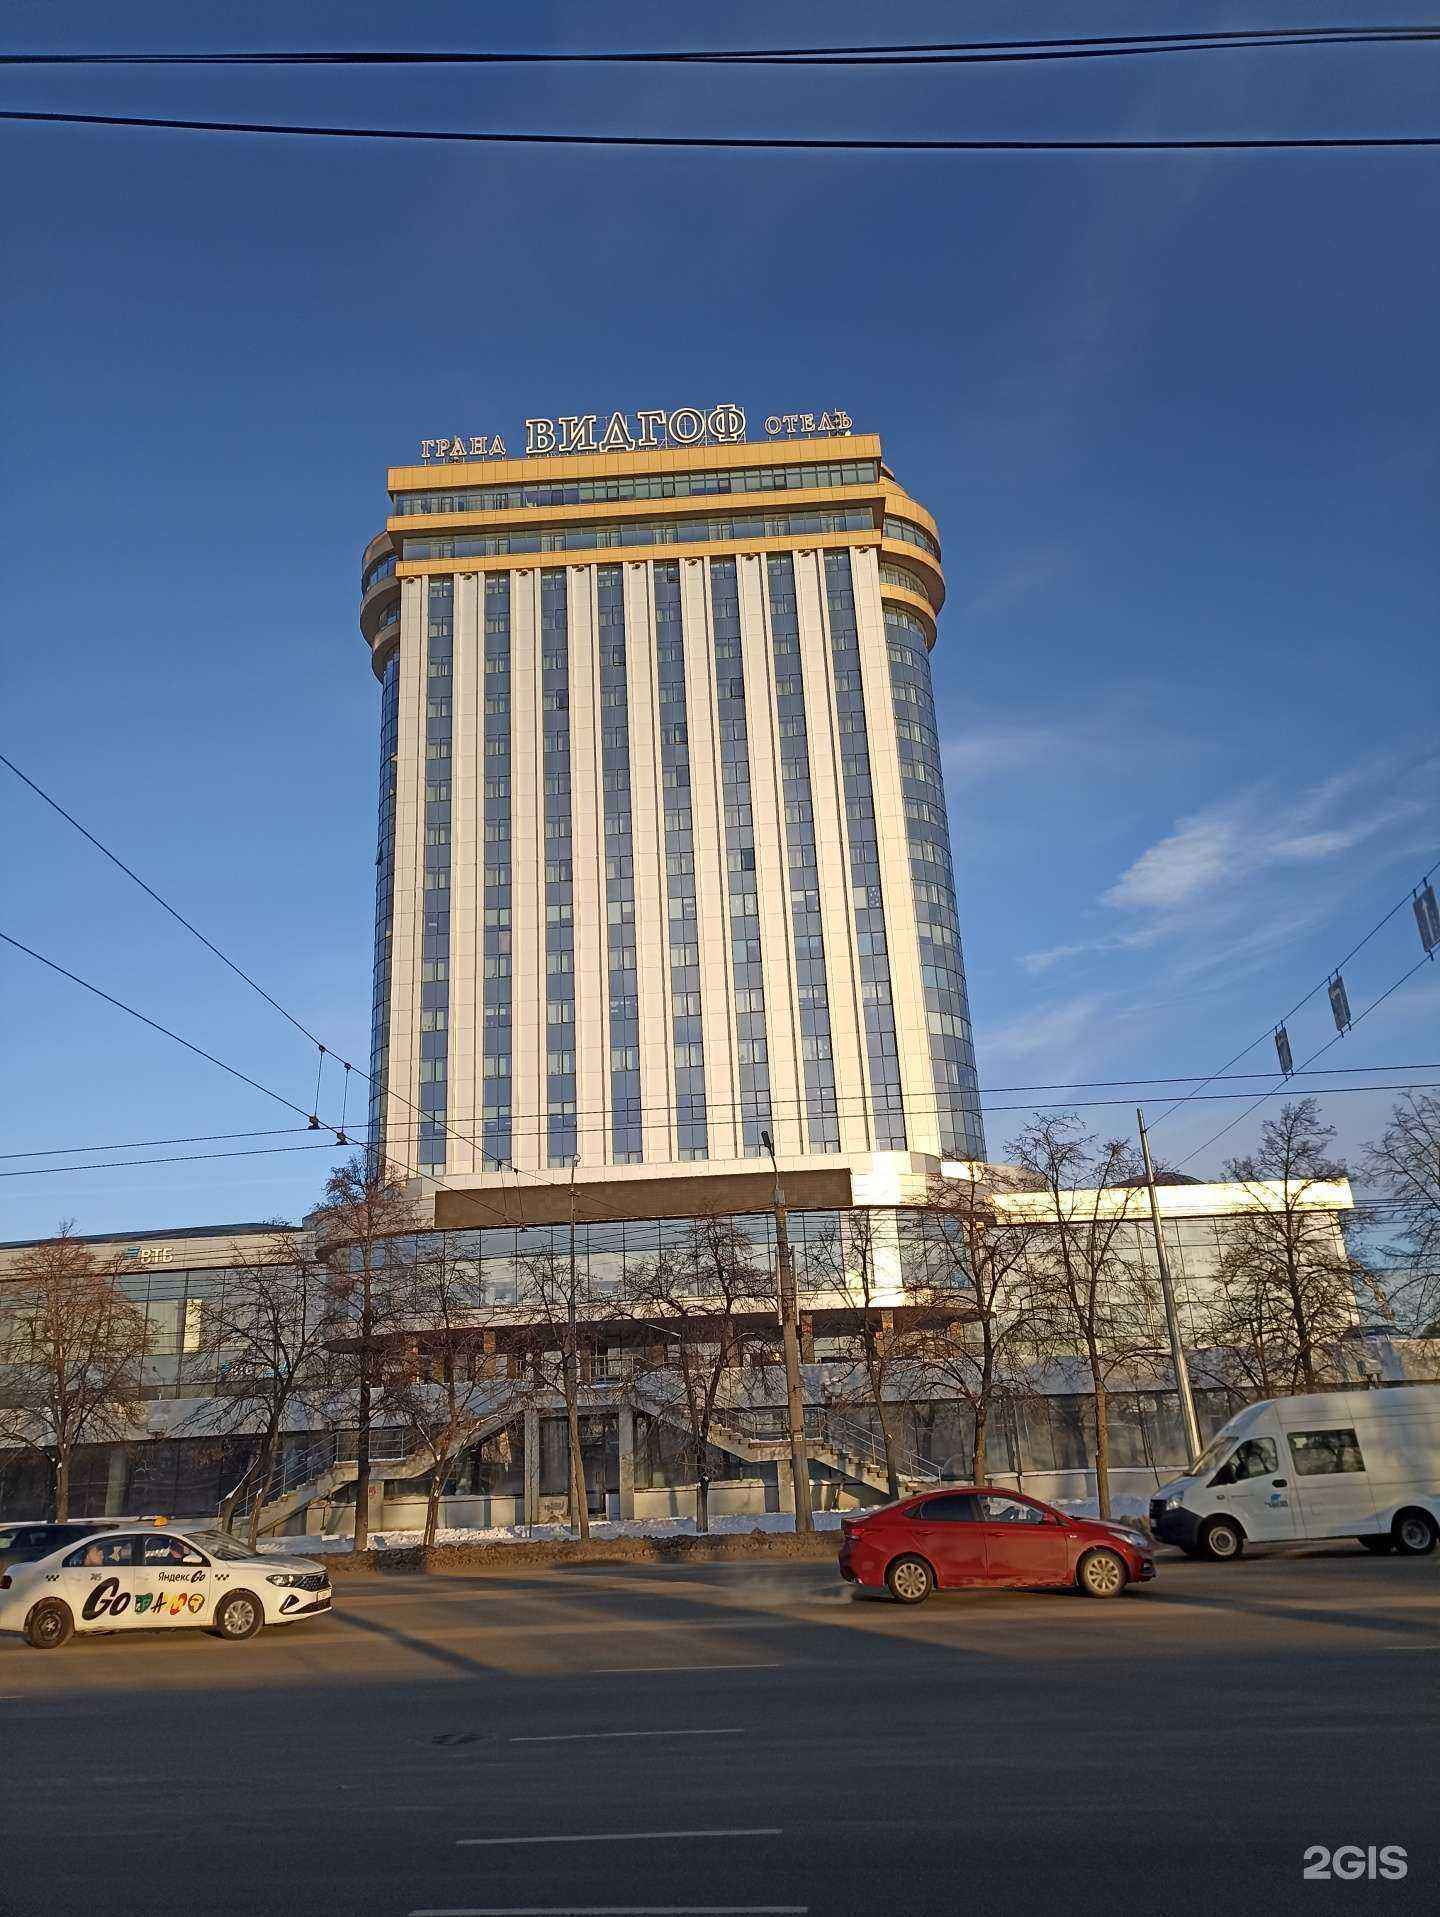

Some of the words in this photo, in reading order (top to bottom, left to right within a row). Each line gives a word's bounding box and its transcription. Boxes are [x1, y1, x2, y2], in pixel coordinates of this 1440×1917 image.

[421, 435, 506, 457] ГРАНД
[526, 404, 746, 453] ВИДГОФ
[764, 411, 853, 434] ОТЕЛЬ
[140, 1247, 173, 1264] ВТБ
[158, 1571, 190, 1582] Яндекс
[191, 1570, 206, 1583] Go
[82, 1577, 131, 1620] Go
